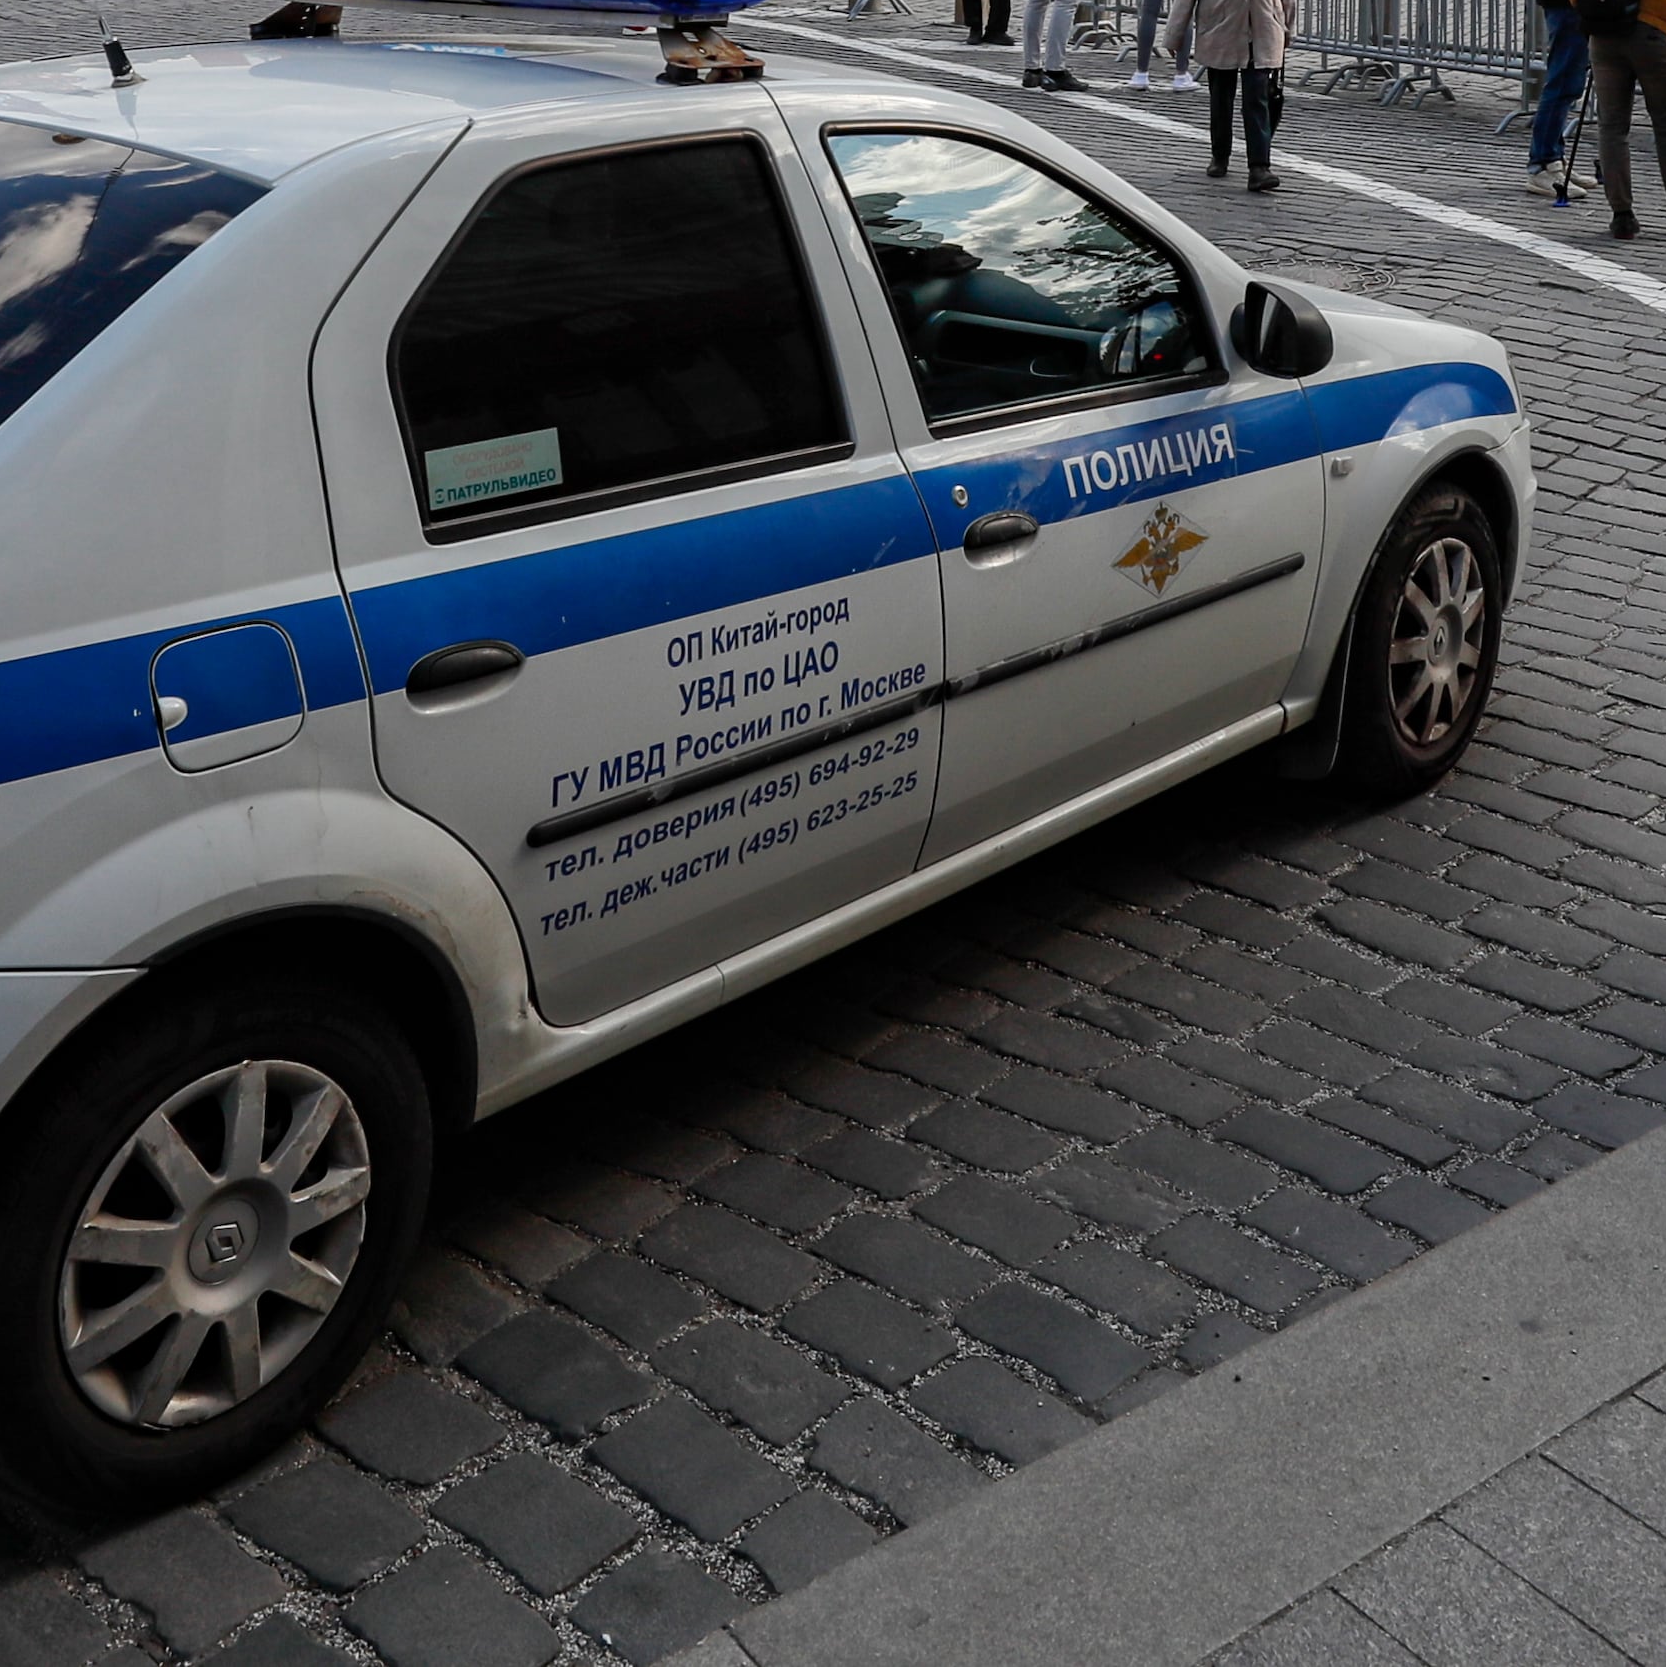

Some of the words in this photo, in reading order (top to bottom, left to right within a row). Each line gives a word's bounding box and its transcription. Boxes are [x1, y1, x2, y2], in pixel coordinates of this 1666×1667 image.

[447, 468, 556, 502] ПАТРУЛЬВИДЕО
[1062, 423, 1235, 498] ПОЛИЦИЯ
[667, 631, 703, 668] ОП
[711, 597, 850, 657] Китай-город
[679, 670, 736, 716] УВД
[743, 667, 775, 697] по
[784, 641, 839, 687] ЦАО
[551, 766, 590, 808] ГУ
[599, 742, 665, 793] МВД
[676, 715, 772, 767] России
[780, 702, 811, 731] по
[818, 695, 832, 719] г.
[840, 663, 926, 710] Москве
[544, 846, 604, 882] тел.
[612, 797, 735, 863] доверия
[739, 771, 801, 818] (495)
[808, 727, 919, 785] 694-92-29
[540, 901, 593, 936] тел.
[738, 818, 799, 864] (495)
[806, 770, 918, 832] 623-25-25
